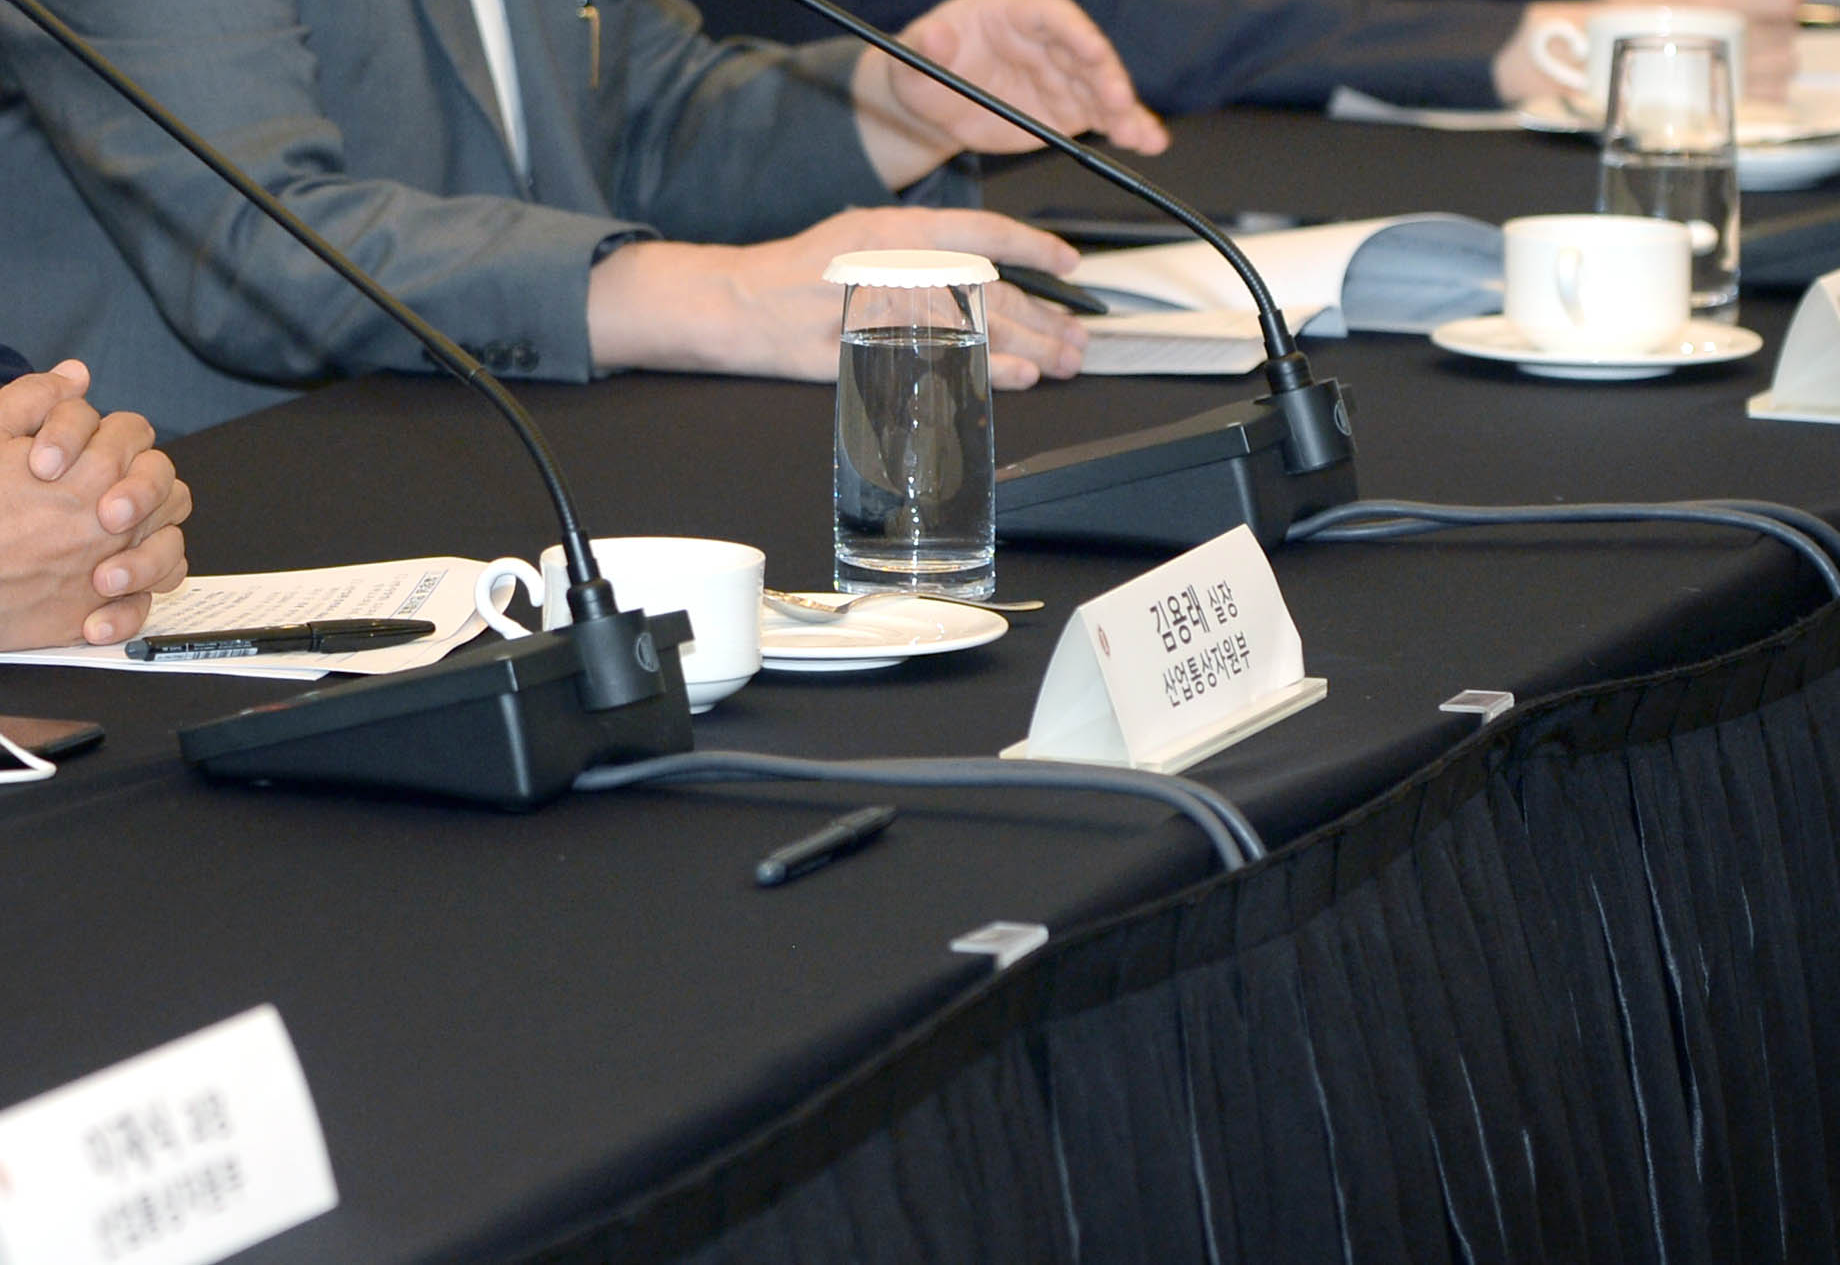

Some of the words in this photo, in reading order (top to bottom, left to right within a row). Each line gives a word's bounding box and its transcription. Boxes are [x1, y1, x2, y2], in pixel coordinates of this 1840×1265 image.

[1150, 584, 1210, 652] 김용래
[1207, 580, 1238, 624] 실장
[1163, 631, 1250, 707] 산업통상자원부
